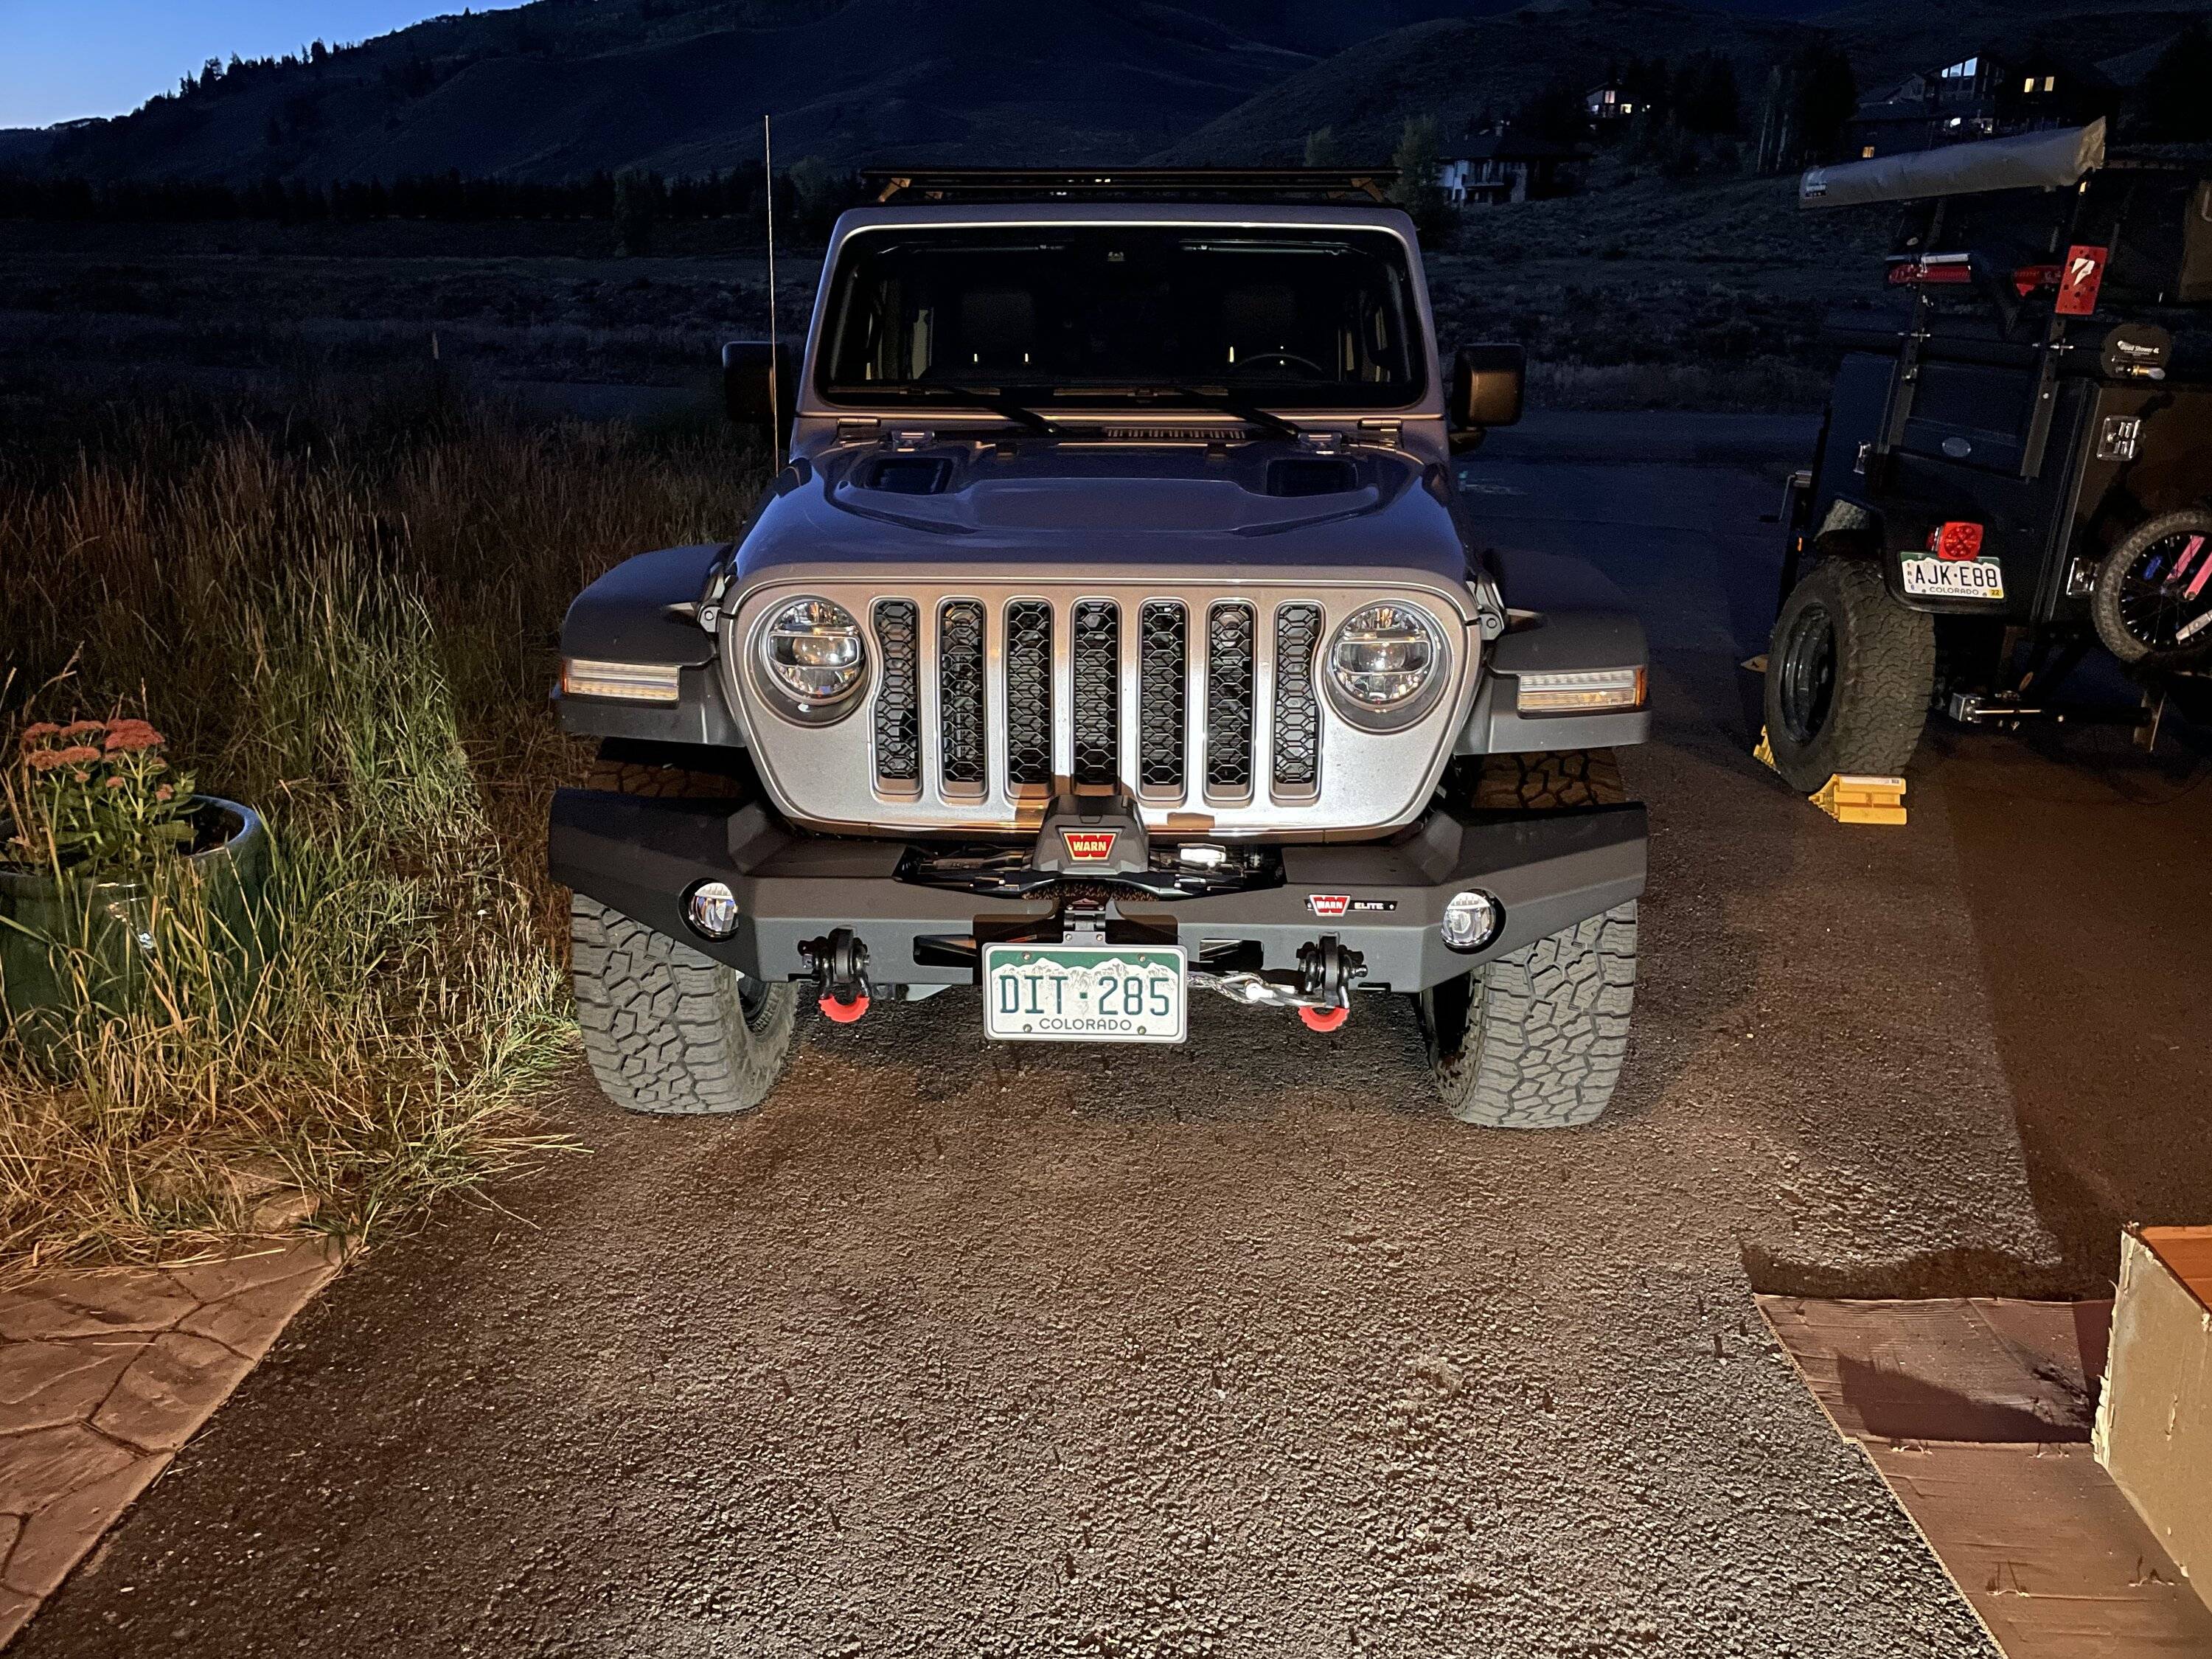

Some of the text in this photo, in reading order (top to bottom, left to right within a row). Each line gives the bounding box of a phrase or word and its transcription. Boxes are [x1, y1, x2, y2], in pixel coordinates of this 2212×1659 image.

[1930, 587, 1979, 595] COLORADO
[1073, 841, 1107, 852] WARN
[1316, 900, 1384, 910] WARN ELITE
[1039, 1018, 1132, 1030] COLORADO
